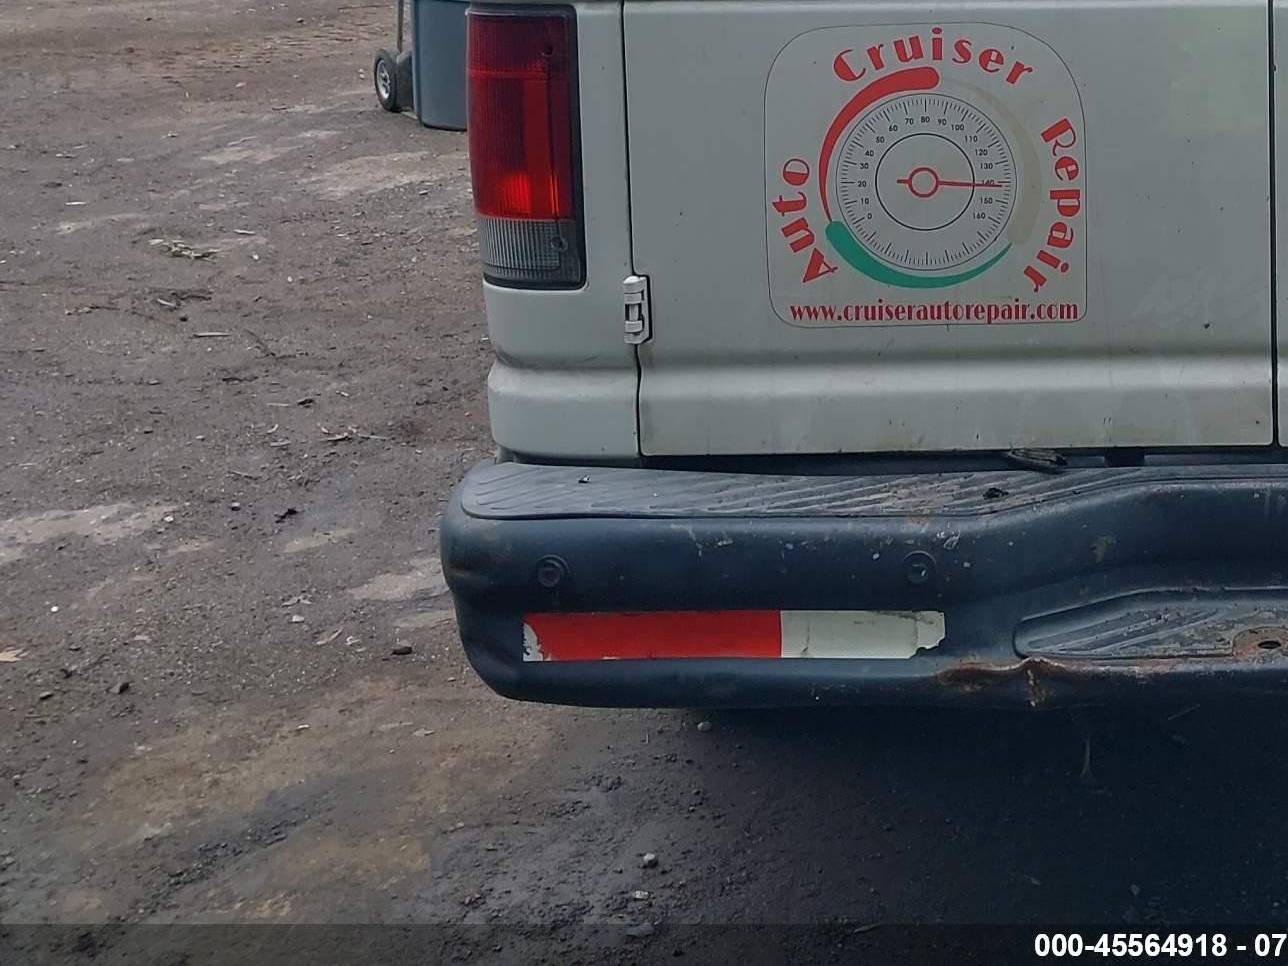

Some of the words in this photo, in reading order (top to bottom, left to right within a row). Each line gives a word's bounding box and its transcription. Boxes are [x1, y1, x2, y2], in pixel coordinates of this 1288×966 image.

[833, 27, 1033, 84] Cruiser
[772, 158, 838, 283] Auto
[1024, 118, 1081, 292] Repair
[790, 299, 1079, 324] www.cruiserautorepair.com
